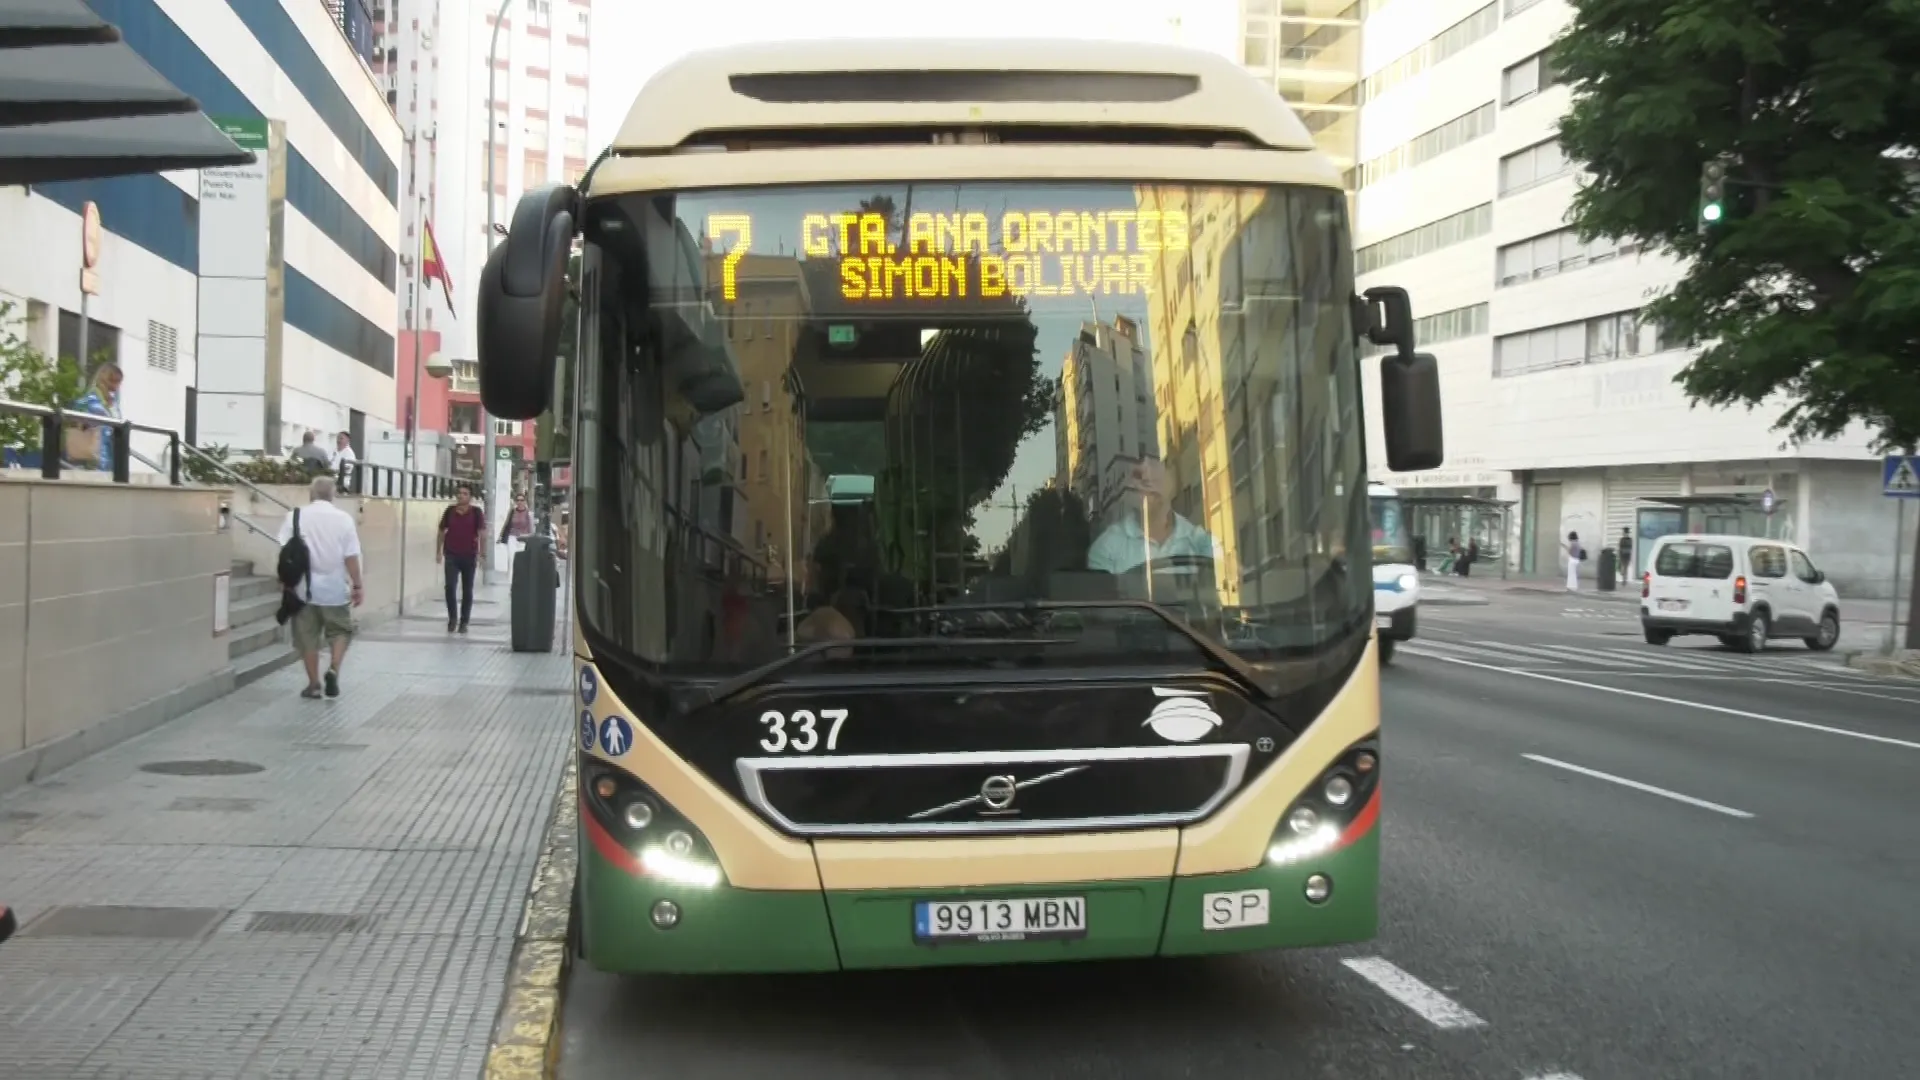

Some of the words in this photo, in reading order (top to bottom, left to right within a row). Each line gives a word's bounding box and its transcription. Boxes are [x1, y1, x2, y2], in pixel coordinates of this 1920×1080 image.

[802, 212, 896, 256] GTA.
[910, 211, 989, 254] ANA
[1002, 209, 1189, 252] ORANTES
[708, 214, 752, 300] 7
[840, 256, 967, 299] SIMON
[980, 255, 1155, 297] BOLIVAR
[759, 707, 850, 752] 337
[936, 903, 1012, 932] 9913
[1023, 900, 1081, 928] MBN
